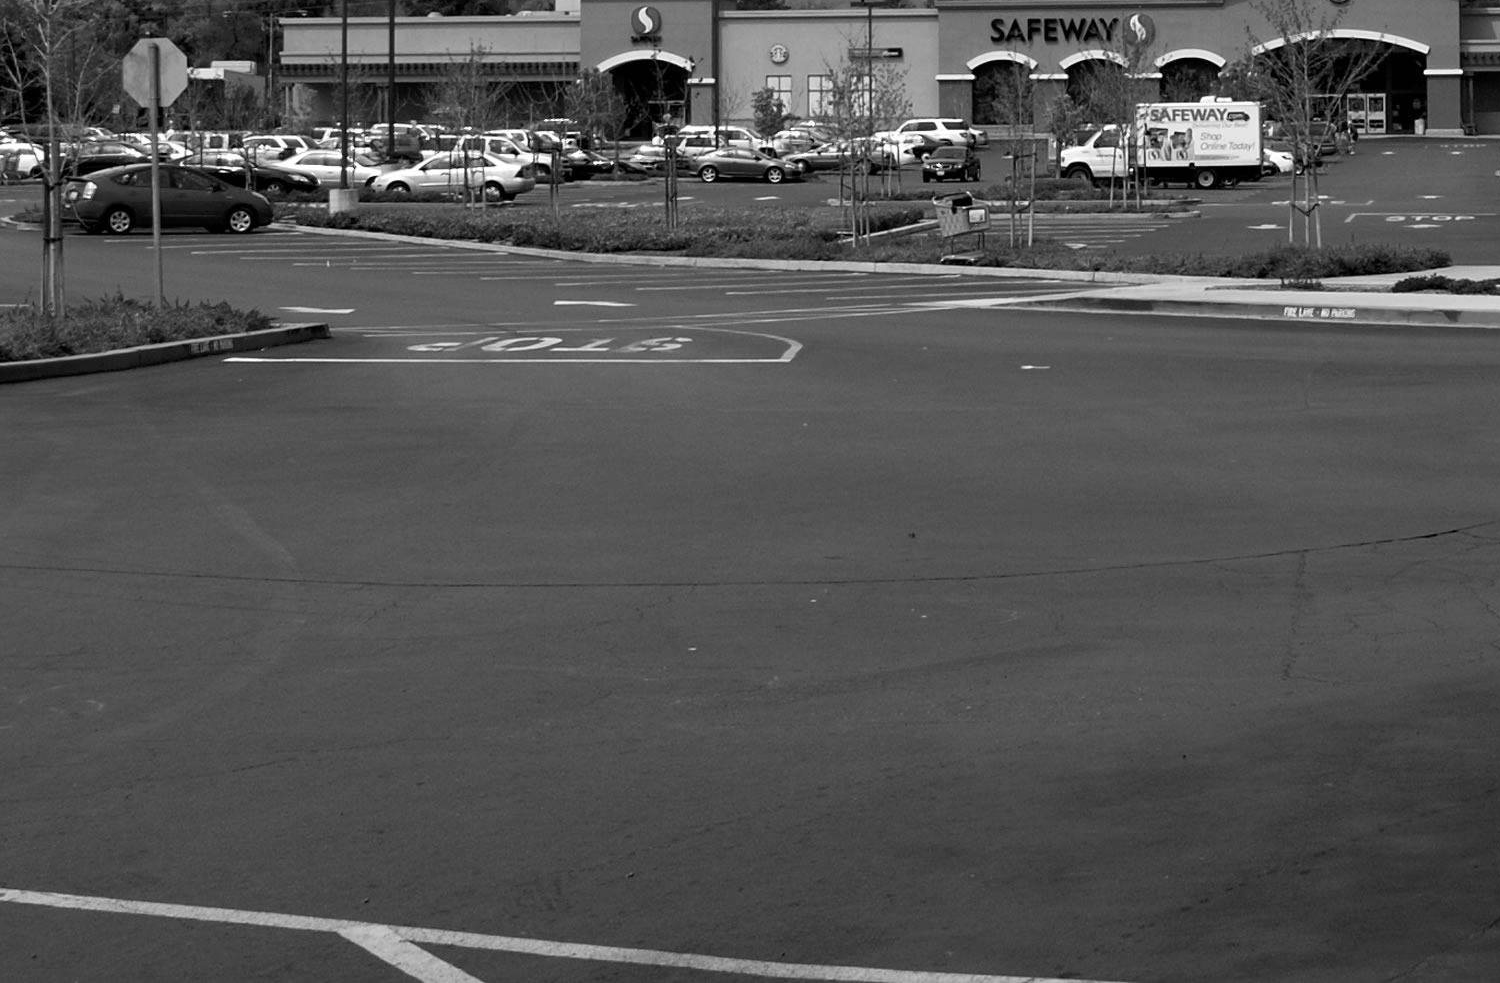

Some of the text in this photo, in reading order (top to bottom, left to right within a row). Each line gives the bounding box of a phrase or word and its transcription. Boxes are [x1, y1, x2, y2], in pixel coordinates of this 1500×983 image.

[990, 17, 1119, 43] SAFEWAY
[1150, 108, 1227, 121] SAFEWAY
[1200, 132, 1222, 141] Shop
[1200, 142, 1255, 151] Online Today!
[1284, 306, 1298, 317] FIRE
[1299, 307, 1315, 317] LANE
[1321, 308, 1330, 318] NO
[1331, 308, 1356, 318] PARKING
[406, 337, 693, 352] STOP
